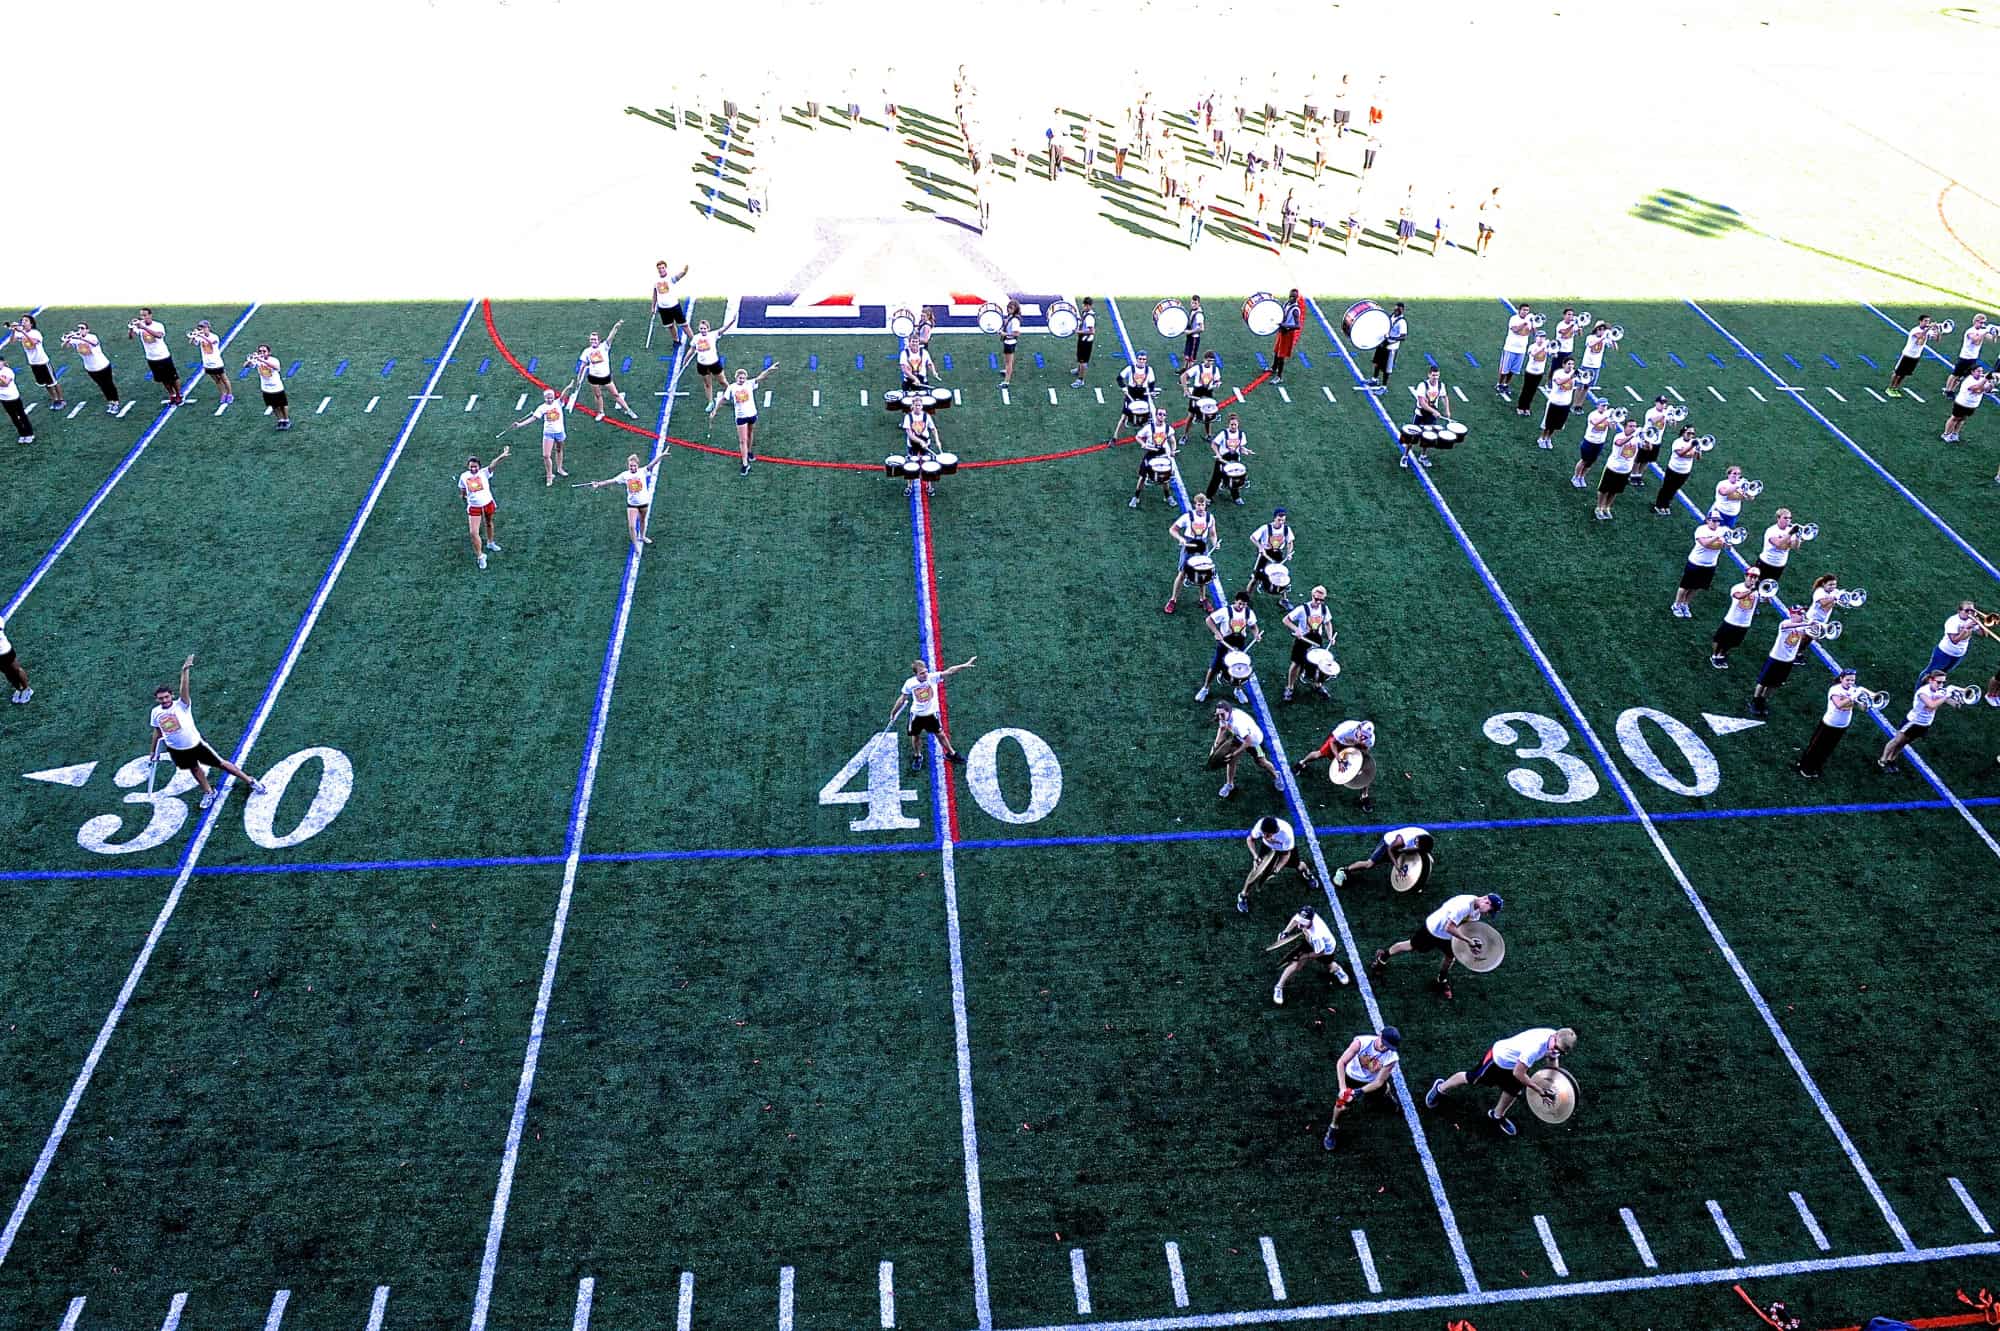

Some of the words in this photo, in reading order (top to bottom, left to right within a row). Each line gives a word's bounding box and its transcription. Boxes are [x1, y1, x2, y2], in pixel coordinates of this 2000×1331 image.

[76, 746, 354, 854] 30
[818, 727, 1063, 832] 40
[1482, 706, 1721, 804] 30
